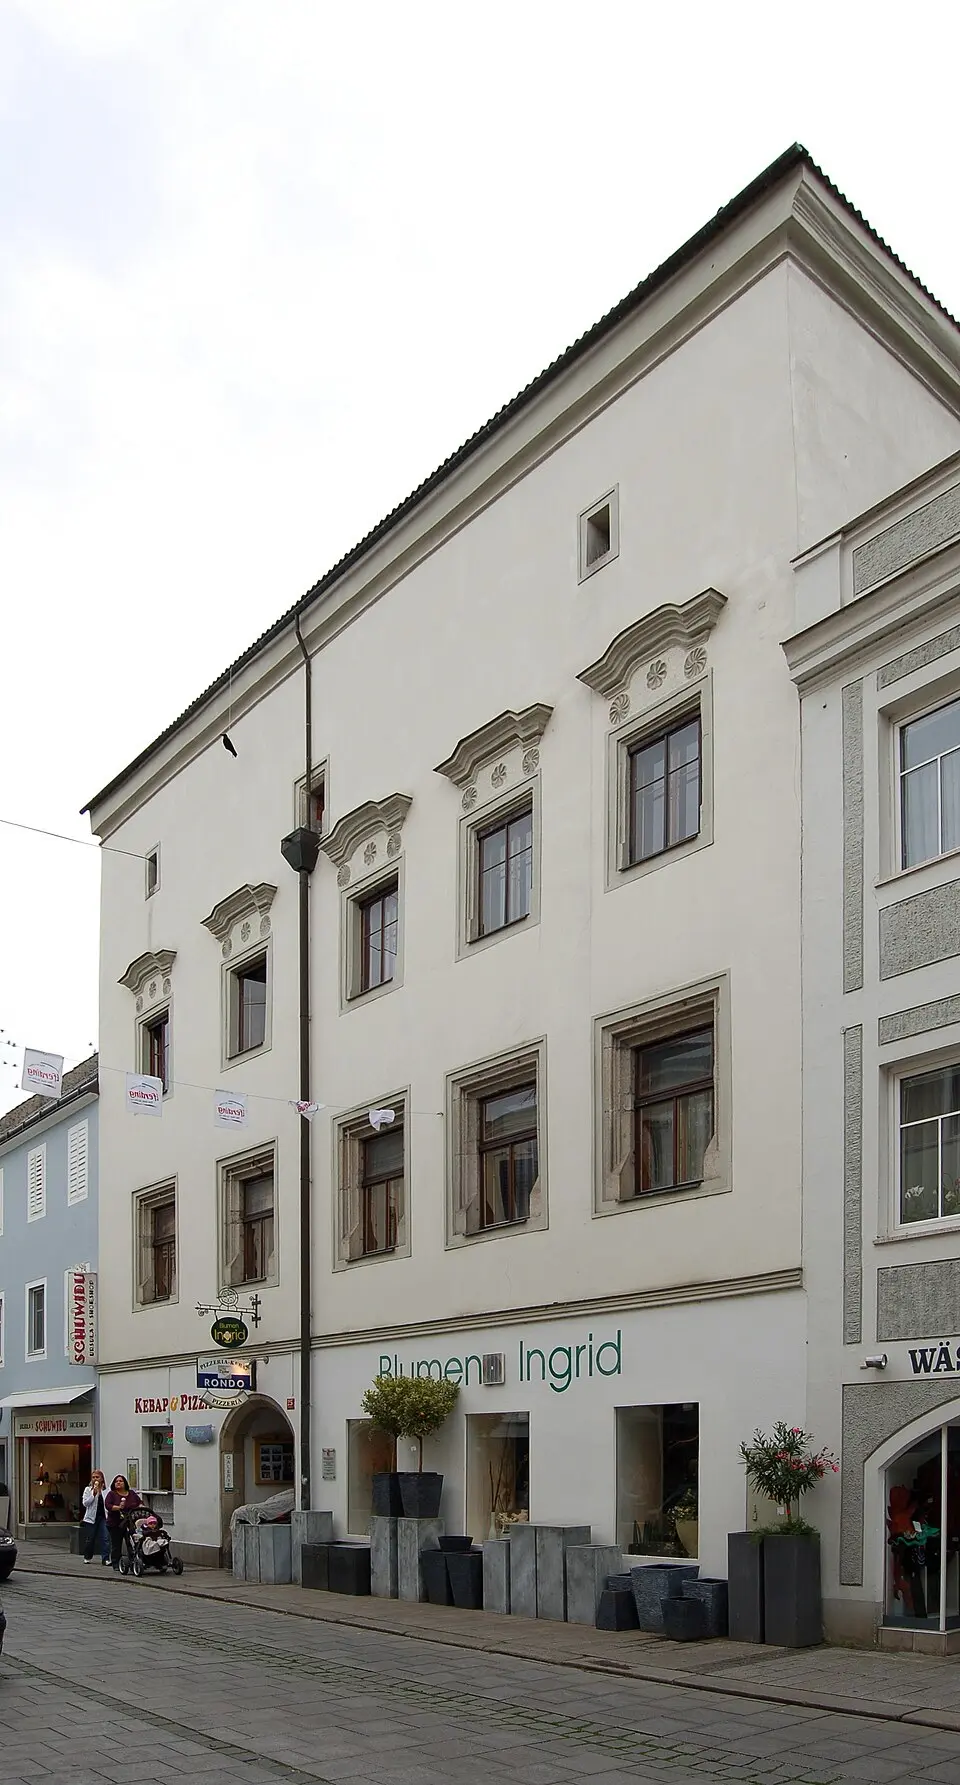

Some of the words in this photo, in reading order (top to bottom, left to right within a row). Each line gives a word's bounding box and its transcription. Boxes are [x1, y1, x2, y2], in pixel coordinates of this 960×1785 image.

[214, 1328, 246, 1344] Ingrid
[519, 1329, 622, 1392] Ingrid
[908, 1341, 960, 1374] WÄ
[204, 1378, 245, 1388] RONDO
[134, 1397, 169, 1414] KEBAP
[211, 1398, 243, 1407] PIZZERIA
